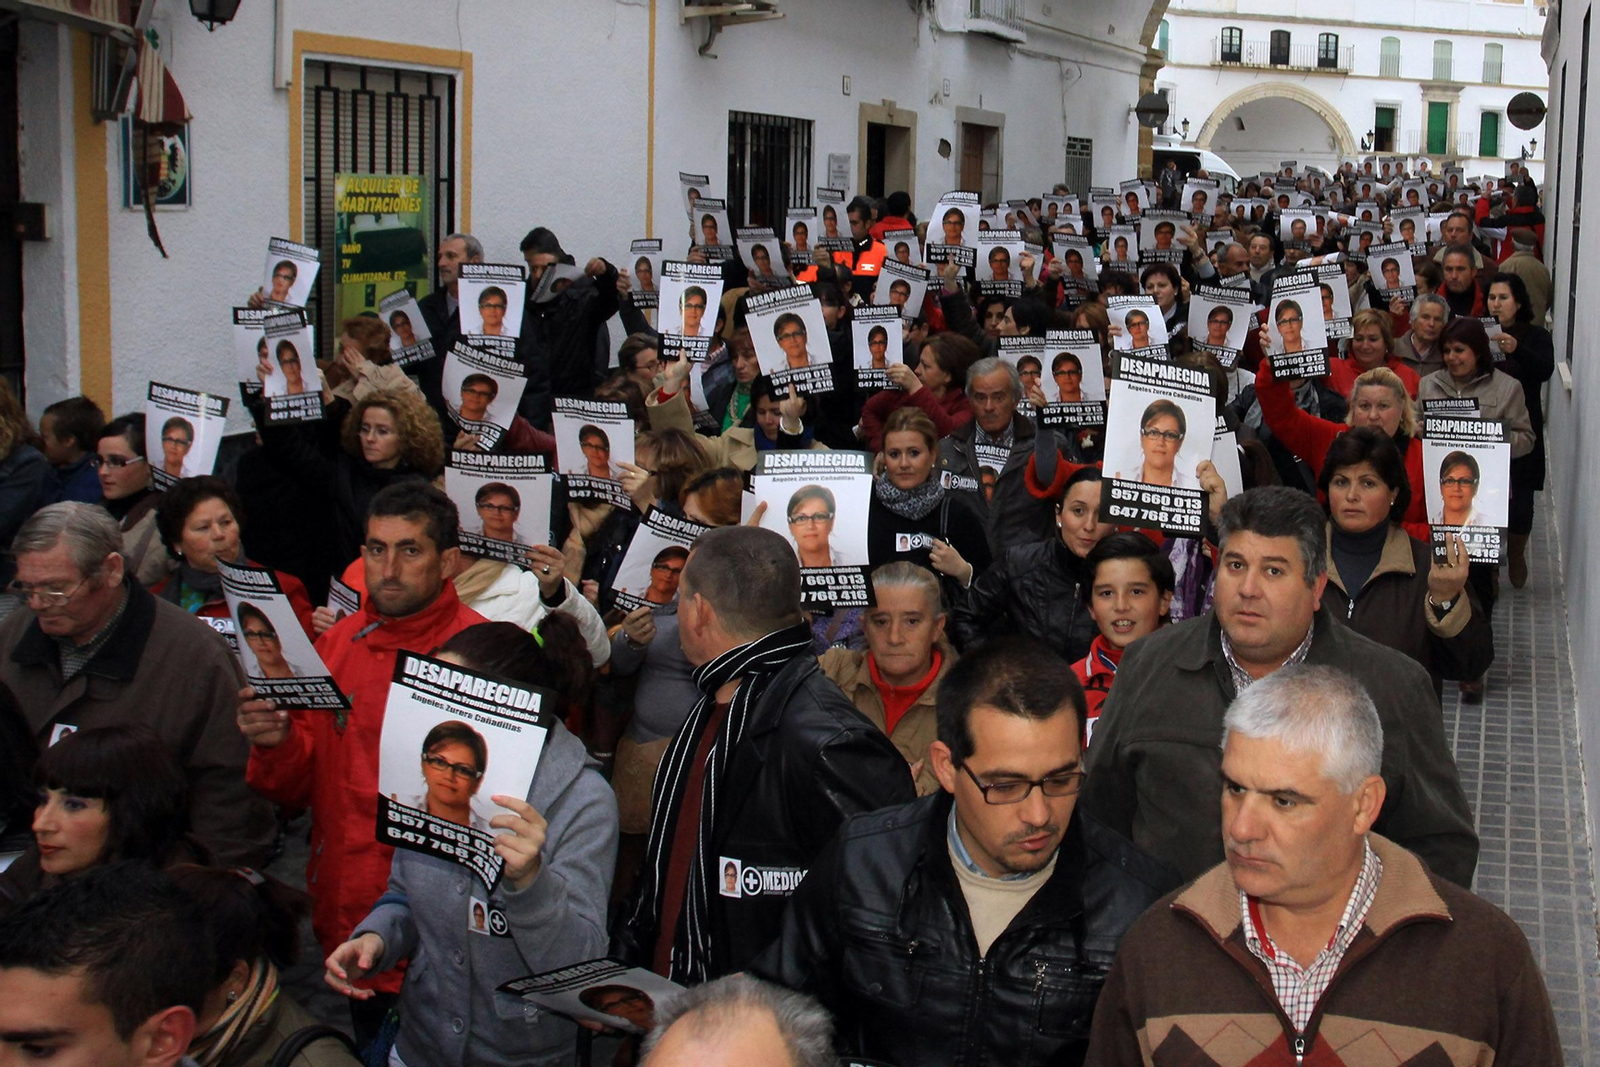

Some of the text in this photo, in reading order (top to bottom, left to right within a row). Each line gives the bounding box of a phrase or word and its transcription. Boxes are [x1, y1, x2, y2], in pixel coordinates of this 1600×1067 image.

[347, 178, 419, 193] ALQUILER DE
[341, 197, 421, 212] HABITACIONES
[342, 243, 361, 254] BAÑO
[1368, 242, 1406, 252] DESAPARECIDA
[342, 259, 351, 268] TV
[462, 264, 522, 276] DESAPARECIDA
[666, 263, 721, 275] DESAPARECIDA
[885, 259, 926, 277] DESAPARECIDA
[746, 284, 812, 308] DESAPARECIDA
[1200, 285, 1250, 299] DESAPARECIDA
[1107, 295, 1154, 304] DESAPARECIDA
[854, 306, 897, 316] DESAPARECIDA
[1000, 337, 1045, 345] DESAPARECID
[455, 341, 524, 372] DESAPARECIDA
[1223, 351, 1236, 360] 013
[1274, 359, 1287, 367] 957
[1306, 354, 1324, 362] 013
[813, 369, 831, 378] 013
[1120, 357, 1210, 387] DESAPARECIDA
[1275, 369, 1290, 377] 647
[1306, 364, 1325, 372] 416
[1128, 375, 1147, 383] Aguilar
[1162, 380, 1185, 389] Frontera
[1186, 384, 1210, 394] (Córdoba)
[1153, 388, 1172, 397] Zurera
[1173, 392, 1202, 402] Cañadillas
[555, 398, 627, 413] DESAPARECIDA
[1426, 400, 1474, 408] DESAPARECIDA
[1044, 416, 1062, 424] 647
[1426, 419, 1503, 435] DESAPARECIDA
[452, 452, 545, 467] DESAPARECIDA
[764, 453, 865, 468] DESAPARECIDA
[593, 491, 613, 500] 768
[1121, 481, 1136, 489] ruega
[1137, 483, 1170, 493] colaboración
[1172, 488, 1200, 497] ciudadana
[1111, 488, 1202, 509] 957 660 013
[1110, 505, 1200, 525] 647 768 416
[1474, 534, 1500, 544] 013
[1472, 549, 1499, 558] 416
[807, 574, 864, 586] 660 013
[811, 590, 867, 602] 768 416
[616, 597, 639, 610] 957
[273, 684, 333, 693] 660 013
[404, 657, 542, 713] DESAPARECIDA
[414, 680, 442, 695] Aguilar
[442, 688, 452, 698] de
[462, 694, 496, 710] Frontera
[446, 703, 472, 718] Zurera
[475, 711, 522, 733] Cañadillas
[389, 801, 397, 809] Se
[398, 806, 420, 817] ruega
[388, 810, 470, 844] 957 660
[388, 827, 497, 883] 647 768 416
[763, 870, 808, 890] MEDIO
[507, 960, 620, 991] DESAPARECIDA
